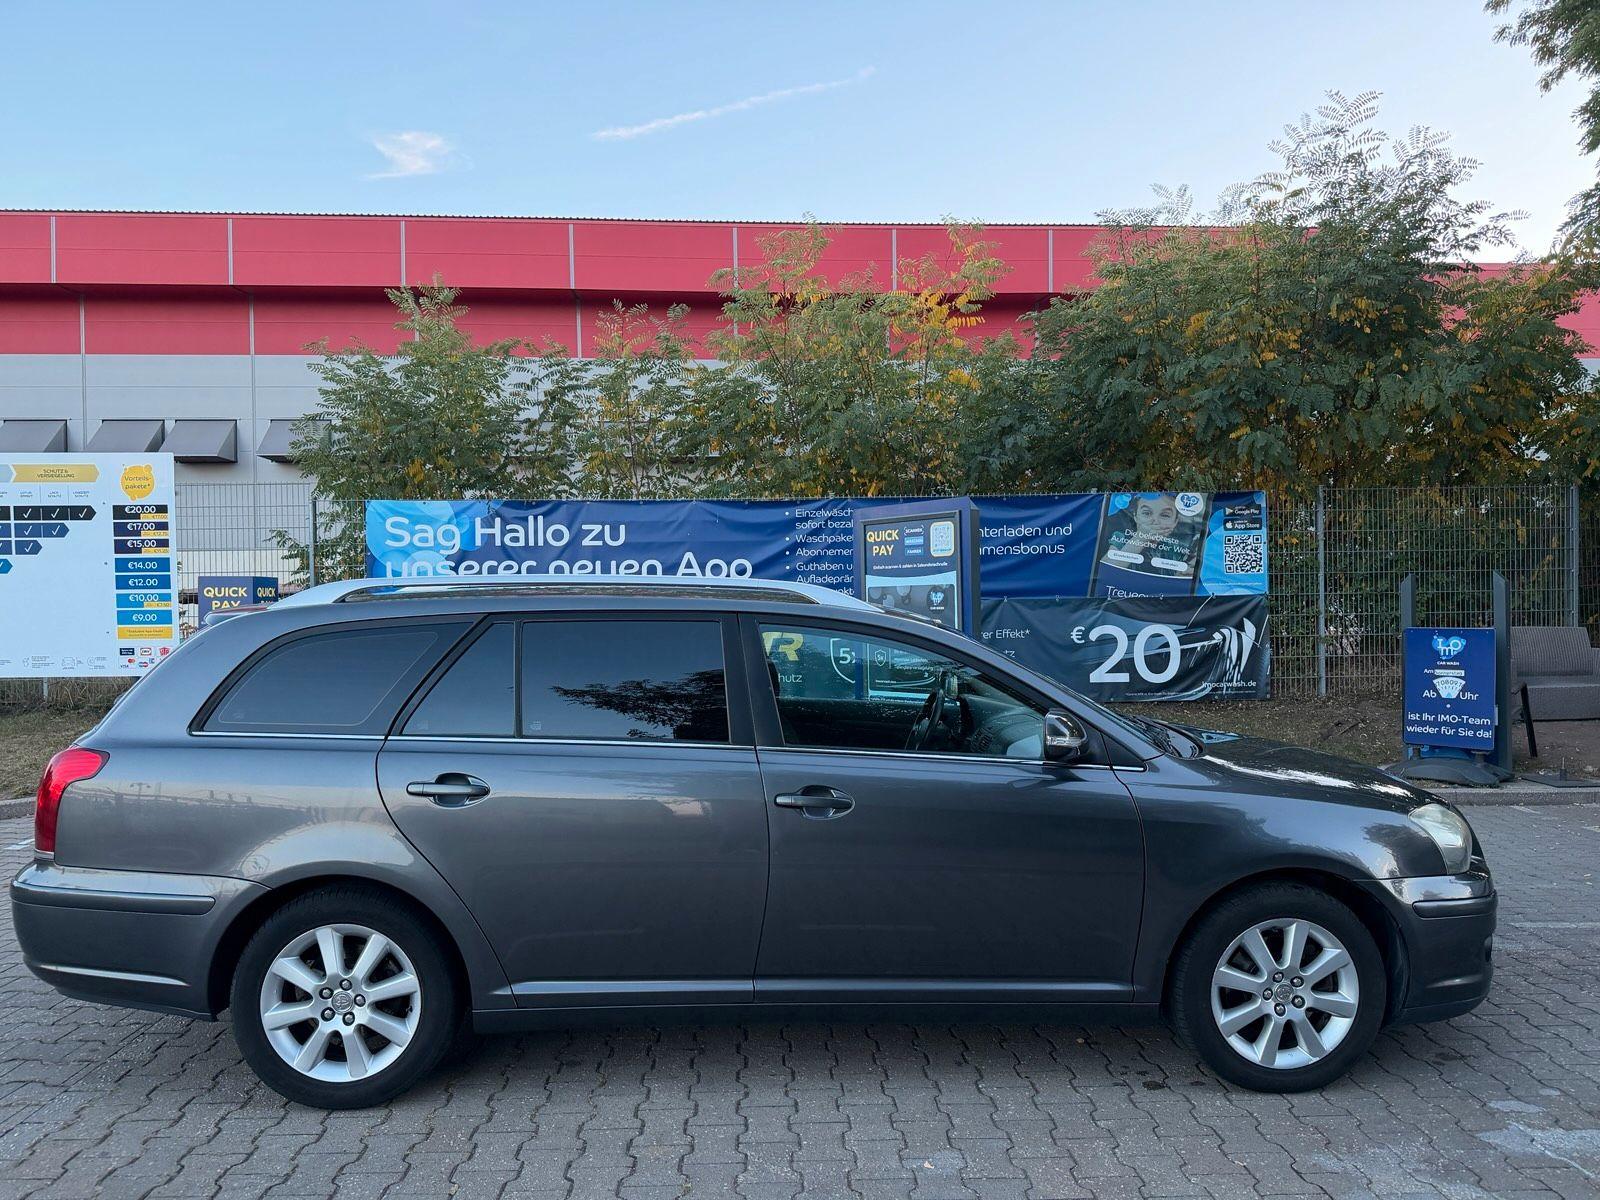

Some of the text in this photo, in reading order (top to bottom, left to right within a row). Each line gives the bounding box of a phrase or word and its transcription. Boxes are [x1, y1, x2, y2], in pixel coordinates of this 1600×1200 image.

[125, 506, 156, 514] €20.00
[127, 522, 156, 530] €17.00
[796, 520, 826, 529] sofort
[1046, 523, 1072, 536] und
[384, 514, 626, 554] Sag Hallo zu
[866, 529, 900, 542] QUICK
[1124, 528, 1137, 538] Die
[127, 540, 156, 548] €15.00
[796, 534, 854, 544] Waschpake
[872, 544, 894, 556] PAY
[980, 542, 1065, 556] mensbonus
[1158, 544, 1172, 552] der
[1174, 548, 1191, 556] Welt
[676, 551, 753, 579] App
[796, 562, 844, 571] Guthaben
[128, 578, 158, 586] €12.00
[204, 587, 248, 598] QUICK
[257, 587, 276, 598] QUICK
[212, 600, 240, 610] PAY
[132, 614, 158, 622] €9.00
[1422, 690, 1479, 700] Ab Uhr
[1408, 712, 1491, 726] ist Ihr IMO-Team
[1406, 724, 1492, 738] wieder für Sie da!
